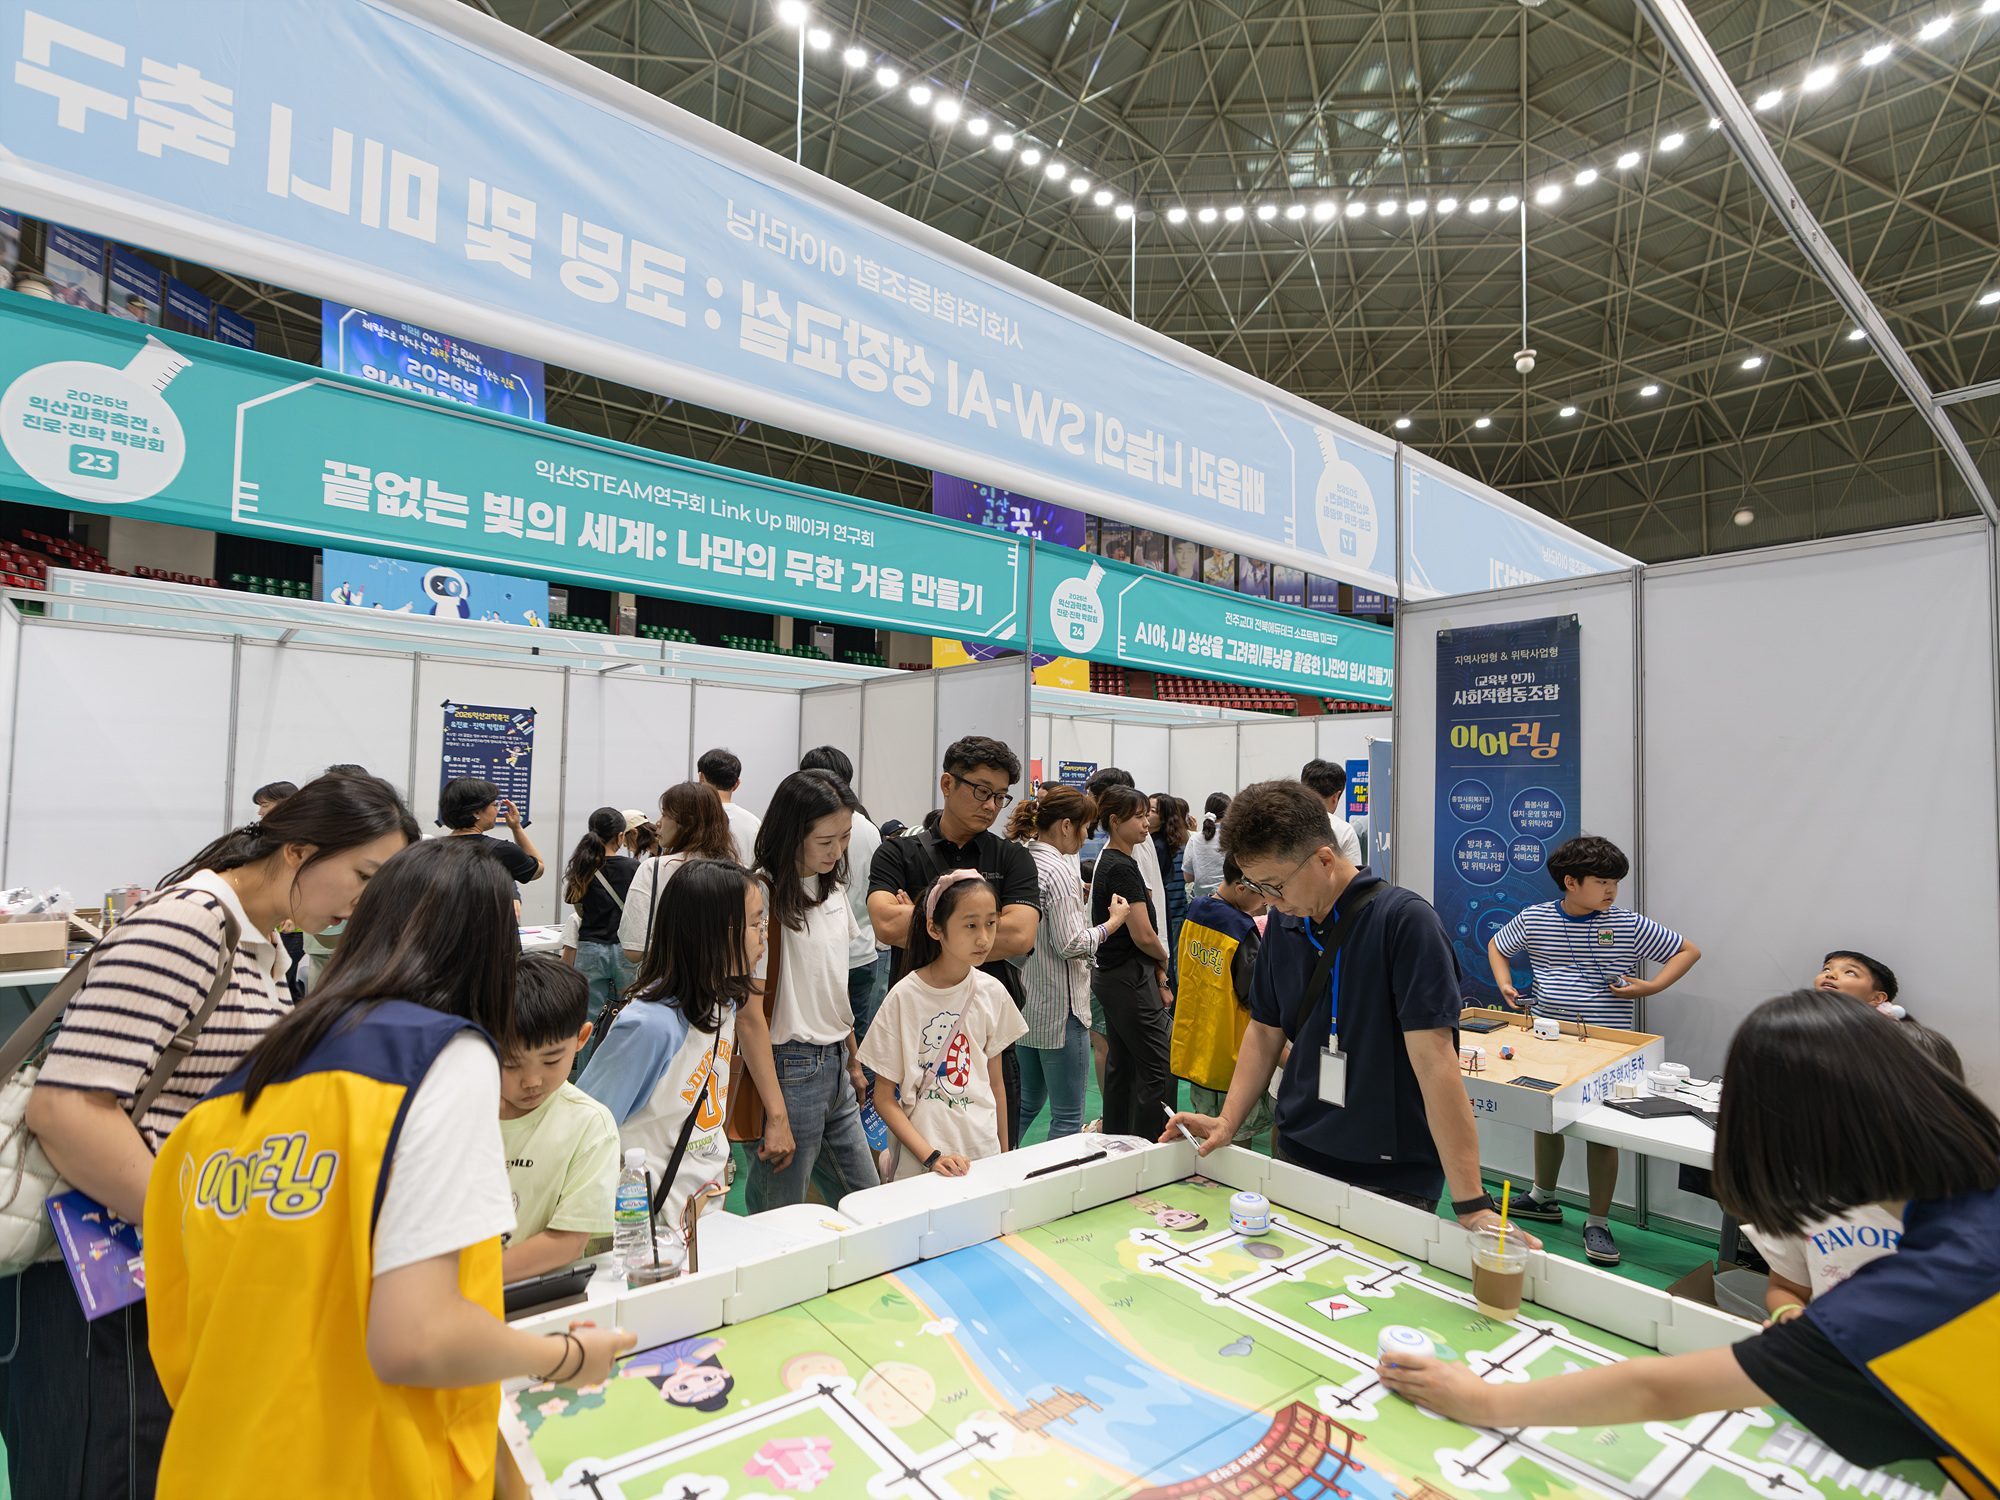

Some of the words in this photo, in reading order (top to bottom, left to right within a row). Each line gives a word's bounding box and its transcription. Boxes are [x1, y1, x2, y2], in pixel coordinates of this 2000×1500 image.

[361, 318, 398, 343] 체험으로
[398, 333, 429, 352] 만나는
[429, 346, 450, 363] 과학
[407, 356, 478, 400] 2026년
[66, 388, 129, 411] 2026년
[28, 395, 149, 432] 익산과학축전
[111, 430, 165, 453] 박람회
[76, 451, 113, 473] 23
[534, 459, 706, 513] 익산STEAM연구회
[710, 498, 751, 523] Link
[755, 508, 782, 530] Up
[785, 514, 830, 539] 메이커
[833, 523, 875, 548] 연구회
[321, 459, 470, 529] 끝없는
[483, 491, 567, 546] 빛의
[577, 511, 668, 562] 세계:
[677, 529, 777, 581] 나만의
[784, 549, 845, 593] 무한
[851, 562, 905, 602] 거울
[911, 572, 983, 616] 만들기
[1072, 626, 1084, 637] 24
[1225, 611, 1254, 630] 전주교대
[1134, 621, 1169, 653] AI야,
[1171, 628, 1186, 652] 내
[1188, 631, 1224, 660] 상상을
[1293, 651, 1321, 676] 활용한
[1322, 657, 1348, 680] 나만의
[1349, 662, 1366, 683] 엽서
[1454, 651, 1498, 665] 지역사업형
[1500, 652, 1509, 661] &
[1511, 646, 1559, 661] 위탁사업형
[1475, 674, 1509, 687] (교육부
[1511, 672, 1536, 684] 인가)
[1452, 684, 1560, 706] 사회적협동조합
[1450, 722, 1560, 759] 이어러닝
[1524, 800, 1550, 809] 돌봄시설
[1548, 810, 1562, 818] 지원
[1528, 819, 1553, 828] 위탁사업
[1467, 839, 1482, 849] 방과
[1513, 844, 1540, 853] 교육지원
[1458, 850, 1488, 860] 늘봄학교
[1489, 851, 1505, 861] 지원
[1461, 861, 1469, 870] 및
[1471, 861, 1501, 872] 위탁사업
[1513, 853, 1540, 862] 서비스업
[1581, 1082, 1591, 1106] AI
[1593, 1053, 1645, 1101] 자율주행자동차
[1812, 1226, 1902, 1256] FAVOR
